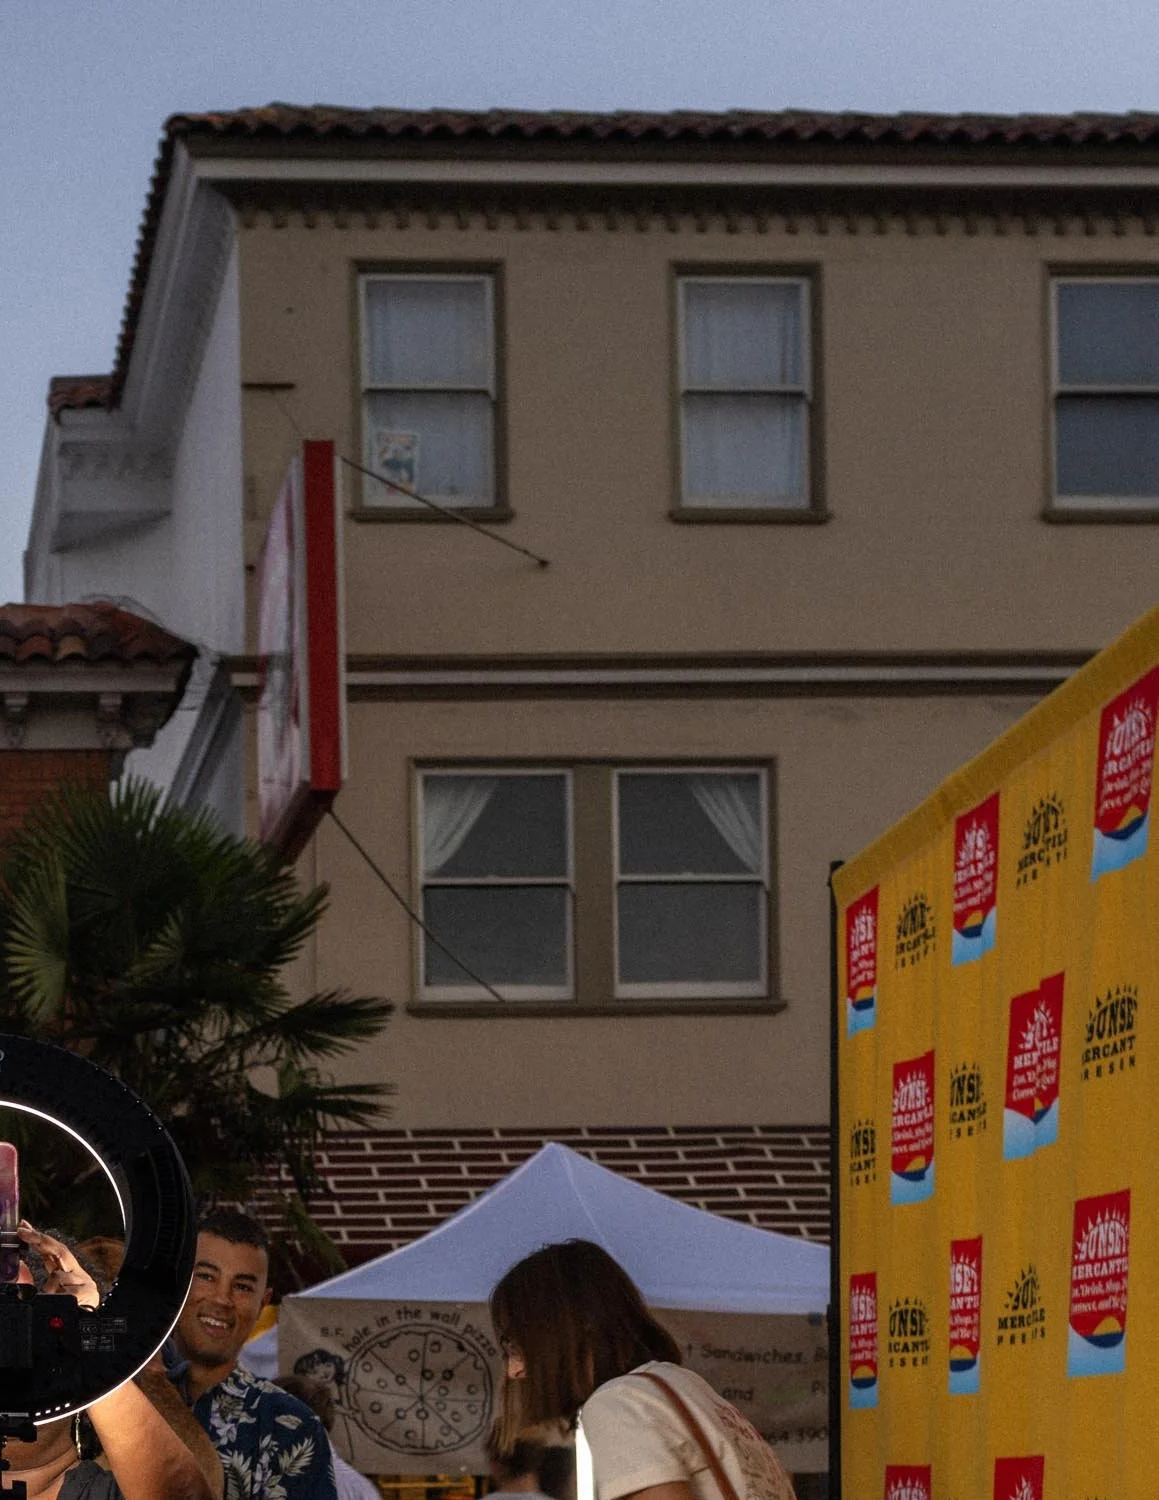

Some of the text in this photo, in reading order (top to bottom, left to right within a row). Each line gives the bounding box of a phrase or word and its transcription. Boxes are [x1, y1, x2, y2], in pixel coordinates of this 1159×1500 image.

[342, 1325, 372, 1354] hole
[376, 1315, 390, 1328] in
[396, 1306, 423, 1321] the
[430, 1311, 461, 1326] wall
[463, 1323, 498, 1357] pizza
